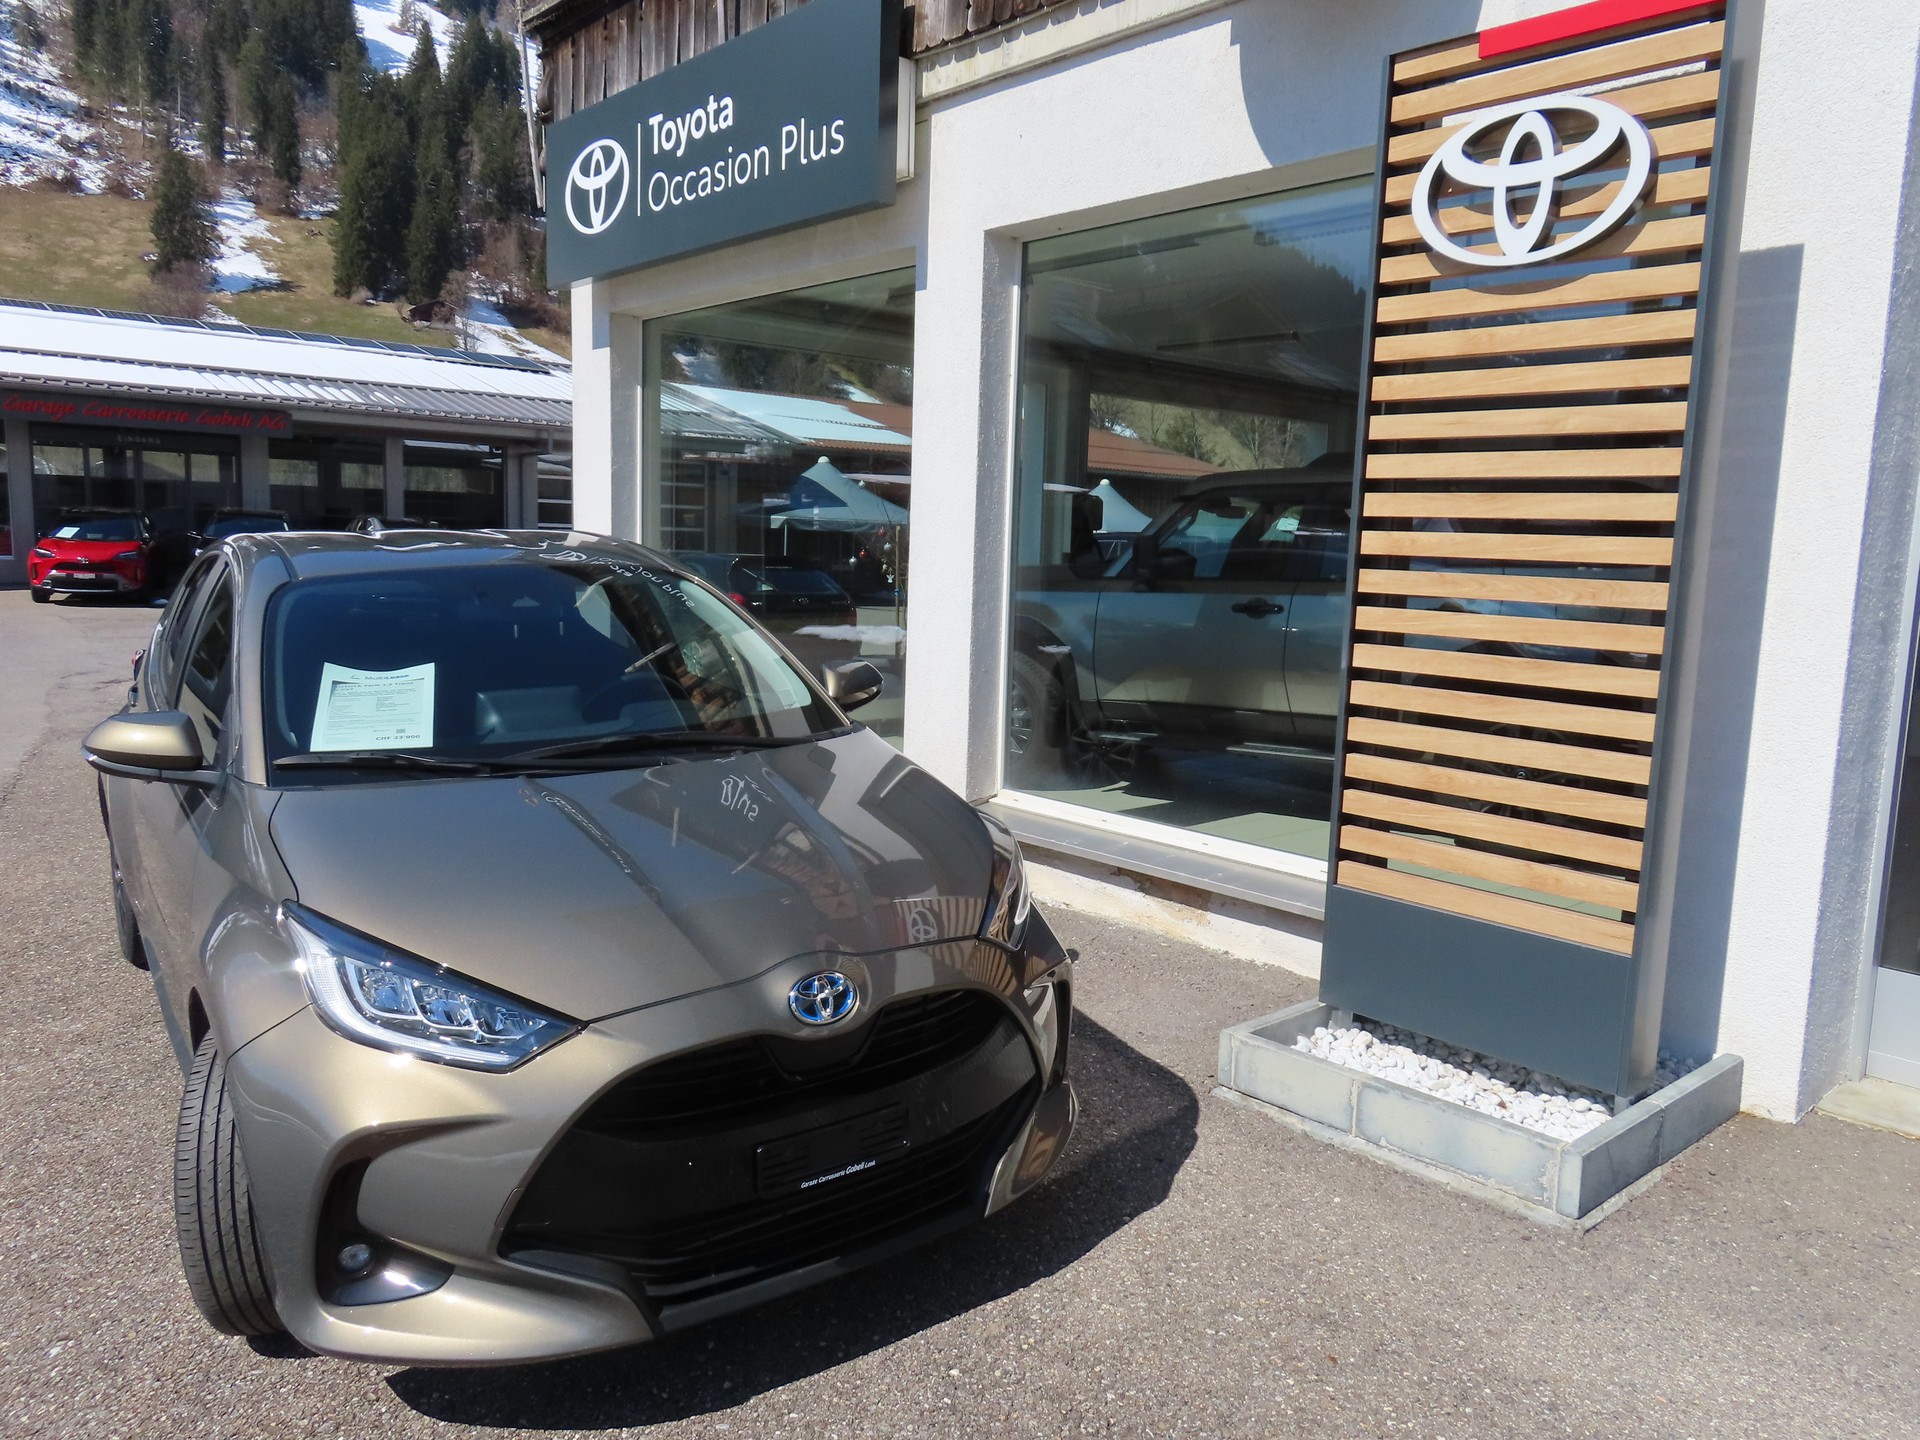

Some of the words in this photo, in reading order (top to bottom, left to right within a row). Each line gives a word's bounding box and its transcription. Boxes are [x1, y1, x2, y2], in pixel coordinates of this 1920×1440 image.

[648, 93, 735, 158] Toyota
[648, 145, 770, 212] Occasion
[780, 117, 846, 171] Plus
[2, 393, 76, 421] Garage
[82, 401, 191, 423] Carrosserie
[196, 409, 253, 428] Gobeli
[258, 413, 287, 430] AG
[845, 1161, 865, 1175] Gobeli
